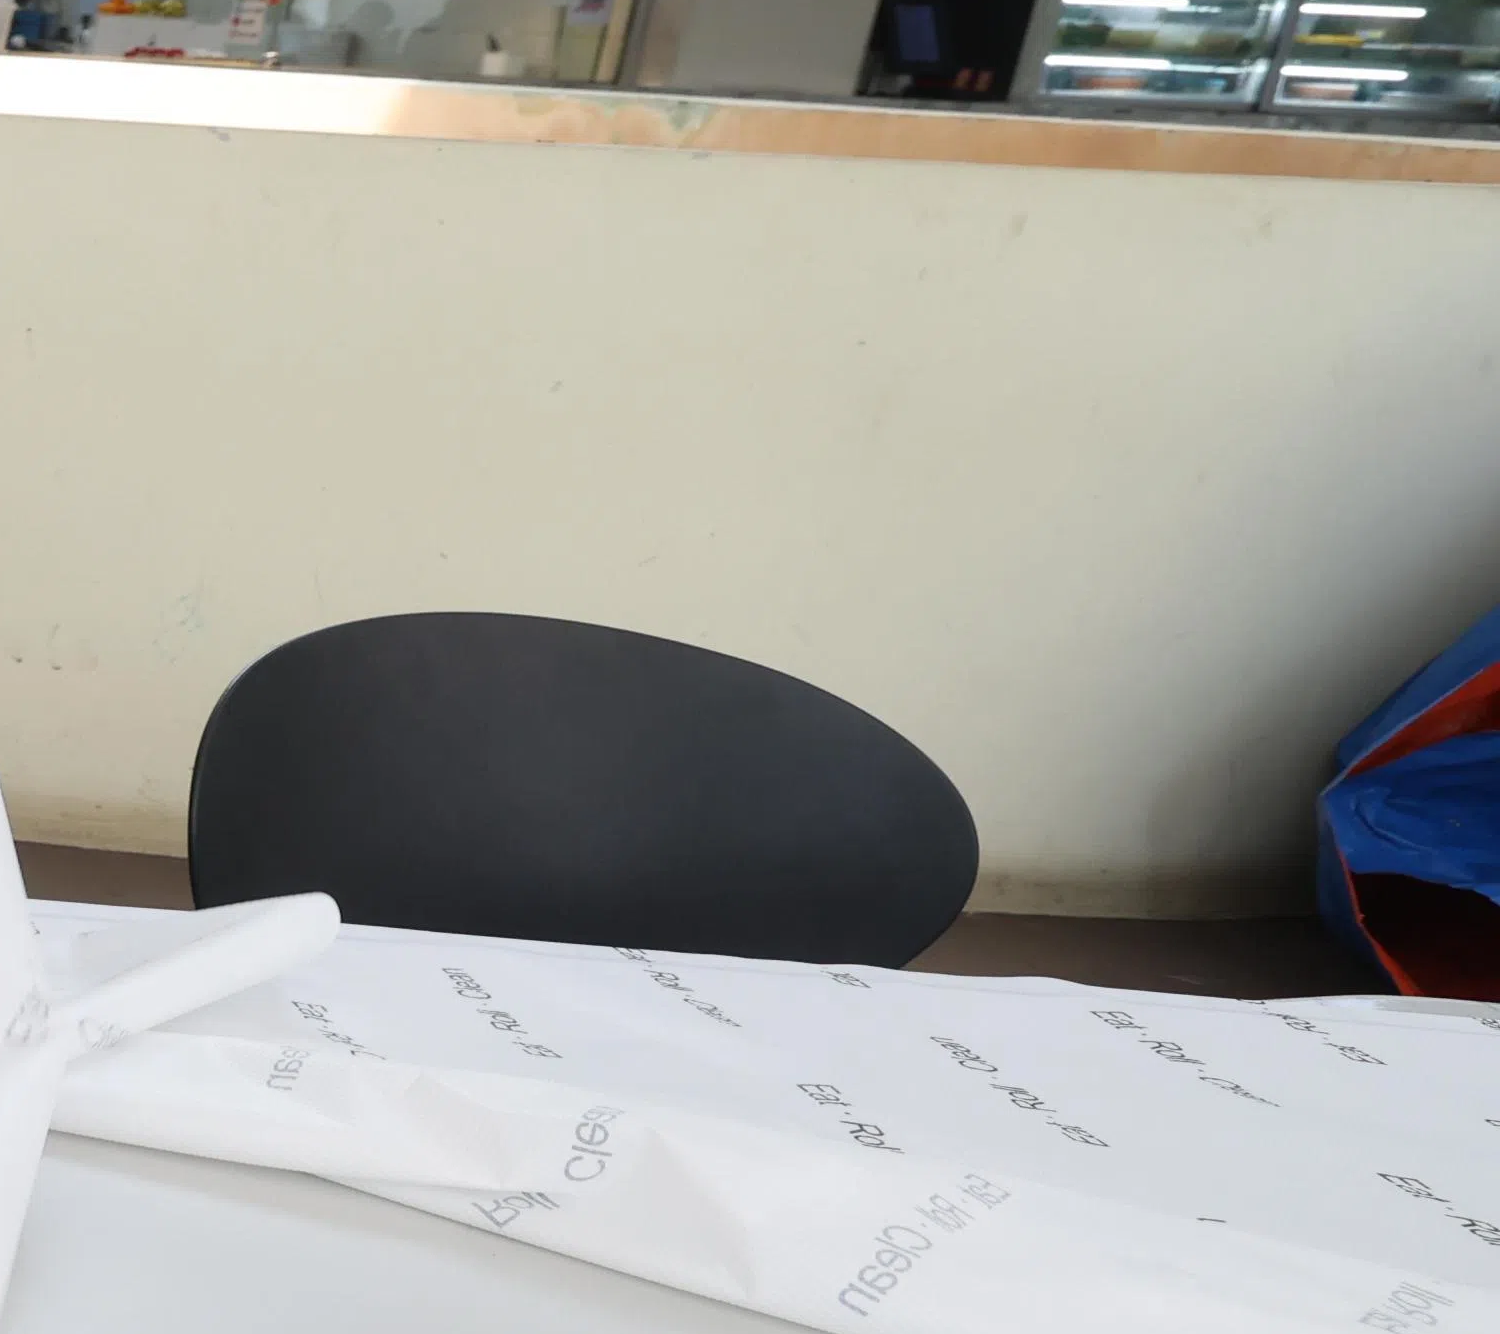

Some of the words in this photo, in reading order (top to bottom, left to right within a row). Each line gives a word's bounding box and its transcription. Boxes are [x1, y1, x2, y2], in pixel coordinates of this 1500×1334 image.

[441, 967, 492, 1001] Clean
[476, 1007, 529, 1035] Roll
[1090, 1010, 1148, 1030] Eat
[1138, 1039, 1206, 1065] Roll
[929, 1036, 999, 1073] Clean
[797, 1083, 853, 1107] Eat
[989, 1083, 1057, 1112] Roll
[1045, 1120, 1111, 1147] Eat
[1375, 1172, 1453, 1203] Eat
